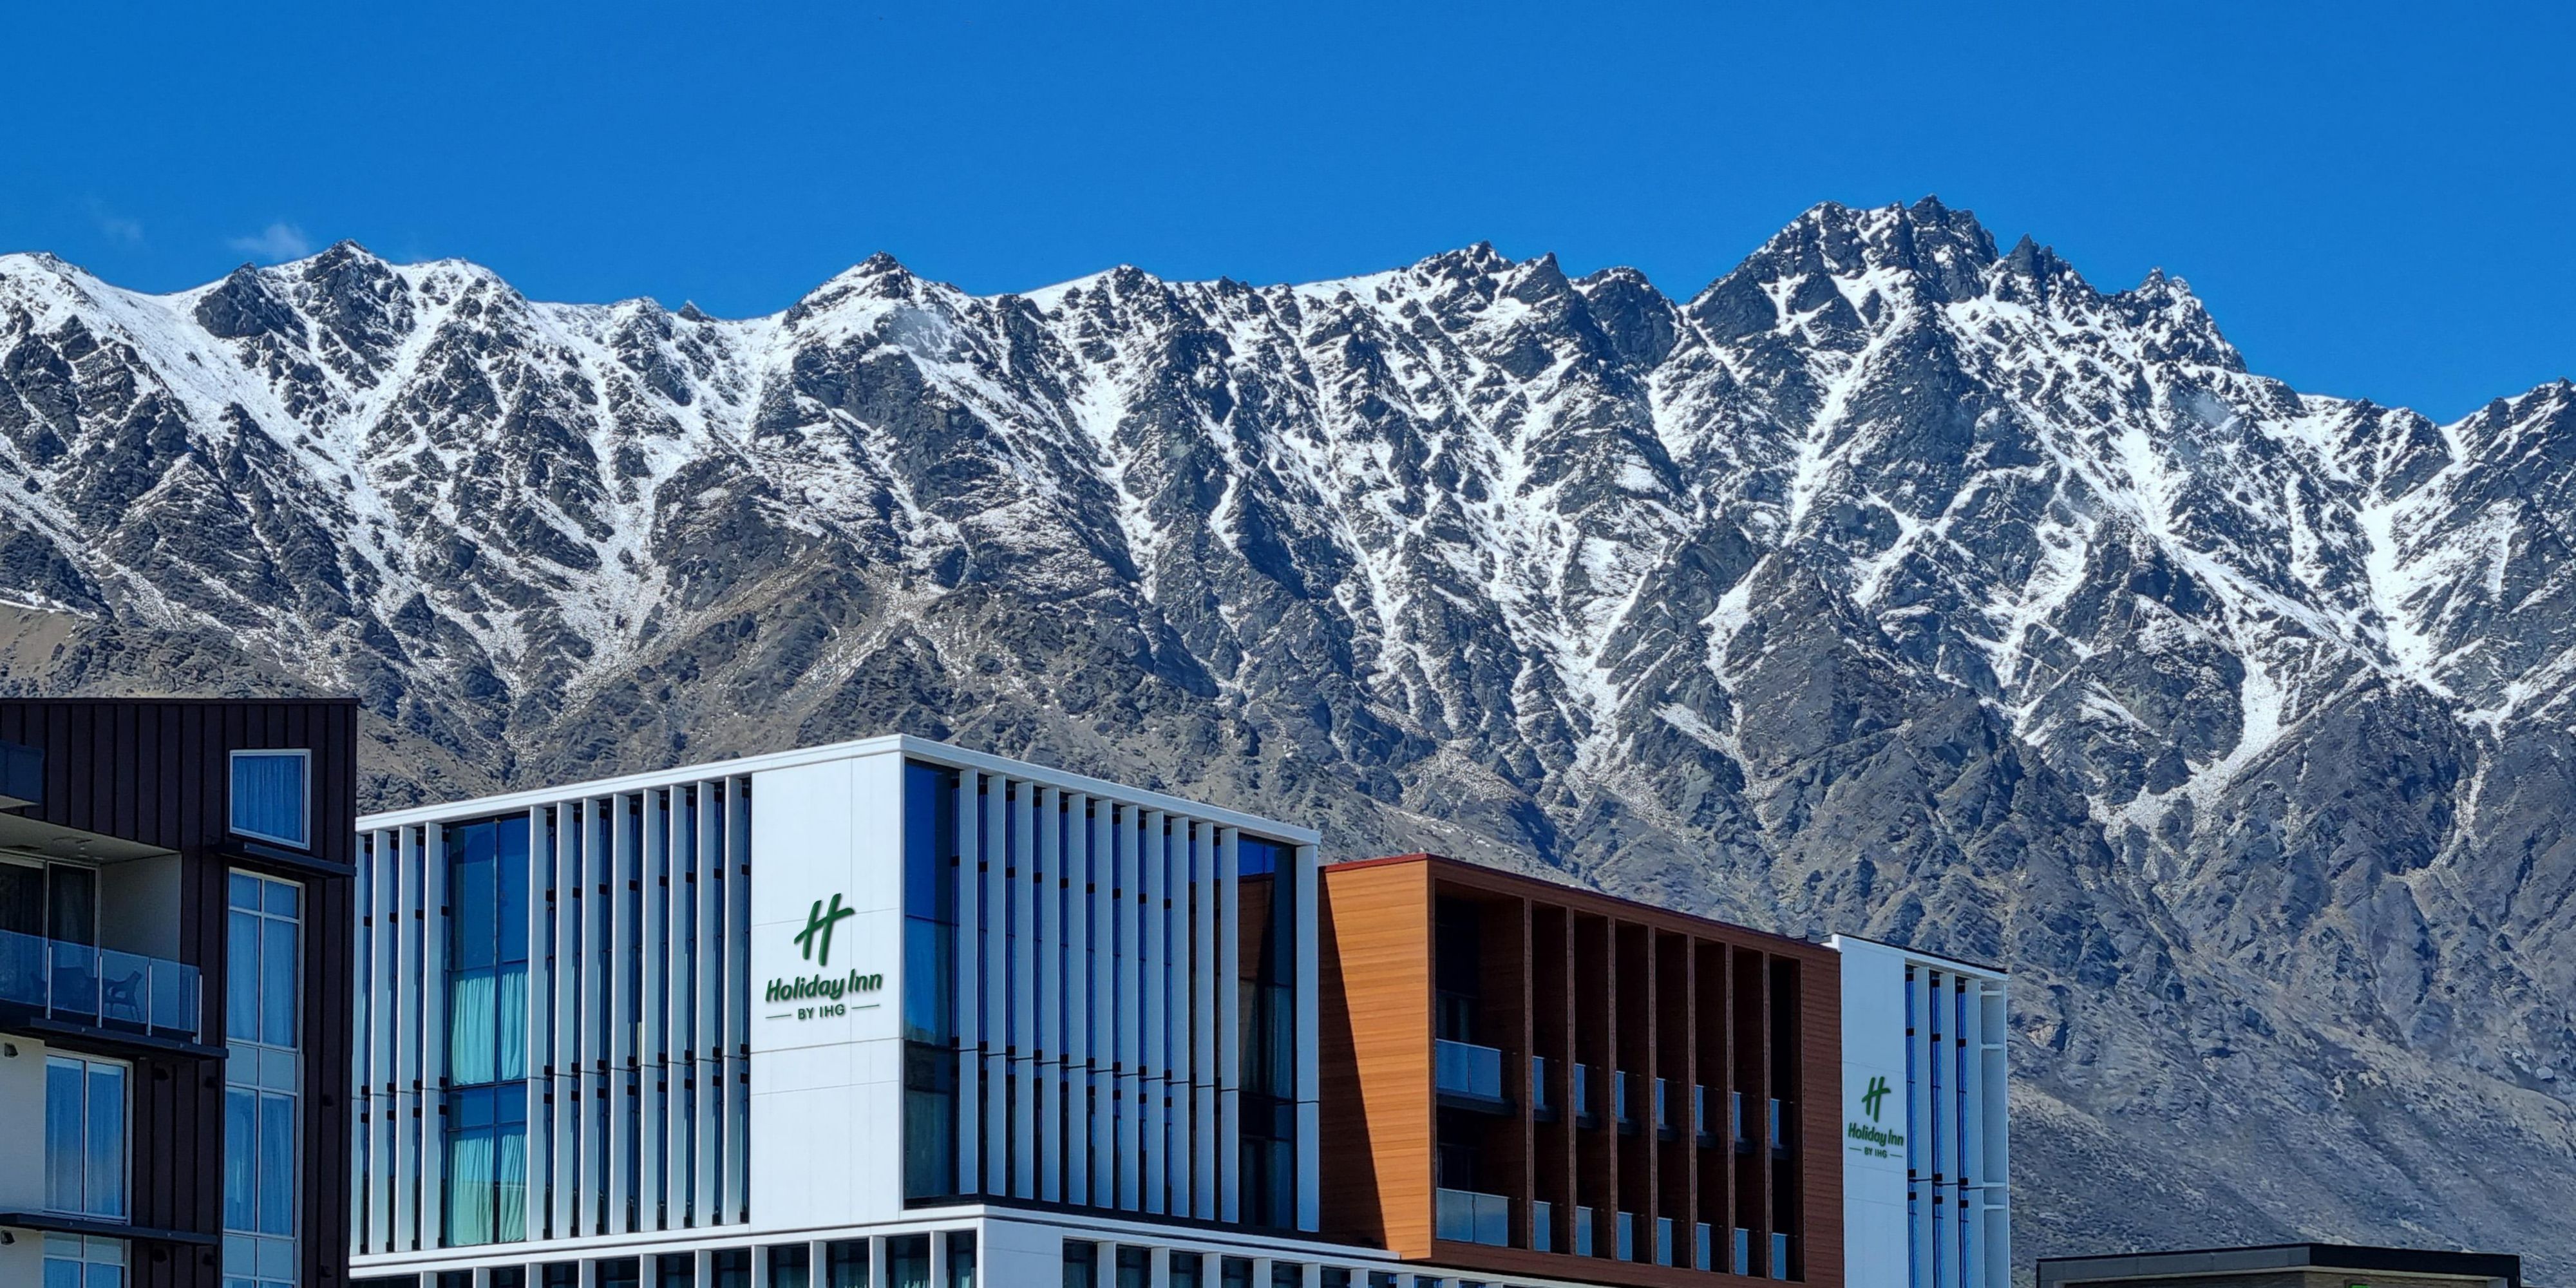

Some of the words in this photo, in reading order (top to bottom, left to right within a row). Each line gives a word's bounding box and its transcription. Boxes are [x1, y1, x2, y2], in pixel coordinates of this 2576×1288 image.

[765, 973, 845, 1001] Holiday
[848, 969, 882, 992] Inn
[798, 1007, 814, 1020] BY
[819, 1004, 845, 1018] IHG
[1848, 1122, 1887, 1147] Holiday
[1888, 1128, 1904, 1146] Inn
[1864, 1146, 1873, 1156] BY
[1875, 1148, 1887, 1159] IHG
